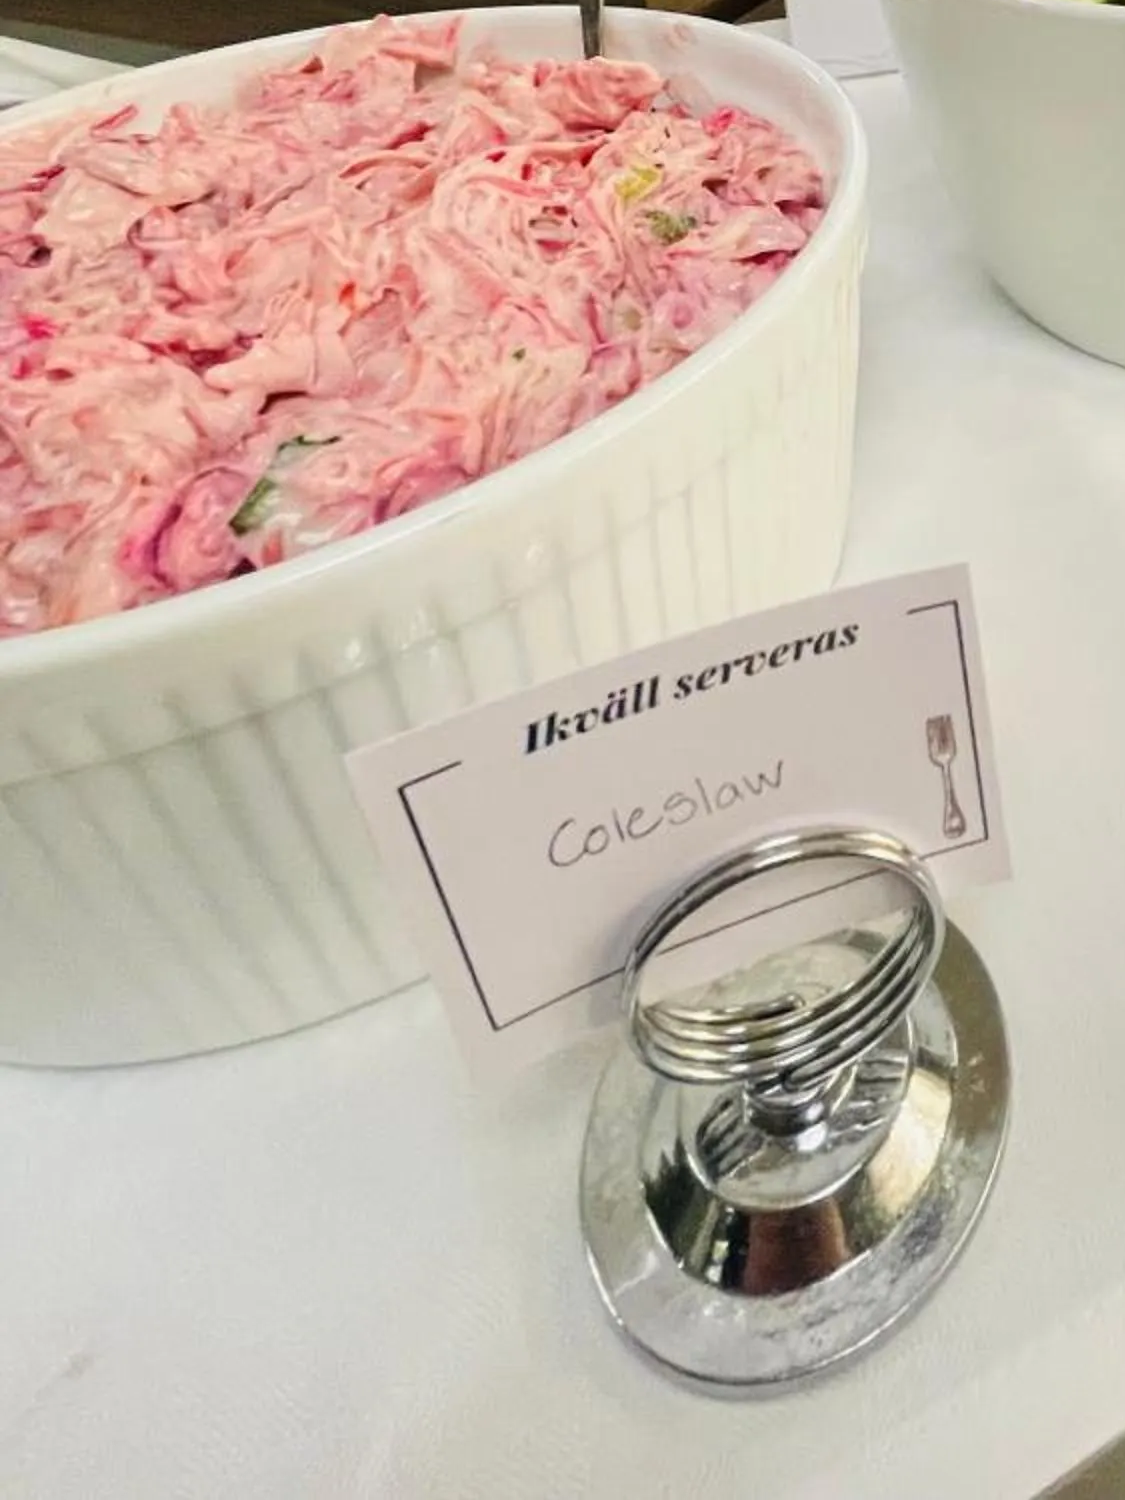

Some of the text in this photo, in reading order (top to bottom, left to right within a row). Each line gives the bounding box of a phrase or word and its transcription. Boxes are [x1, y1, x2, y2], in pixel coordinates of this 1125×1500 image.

[523, 622, 861, 755] Ikväll serveras
[548, 760, 783, 867] Coleslaw
